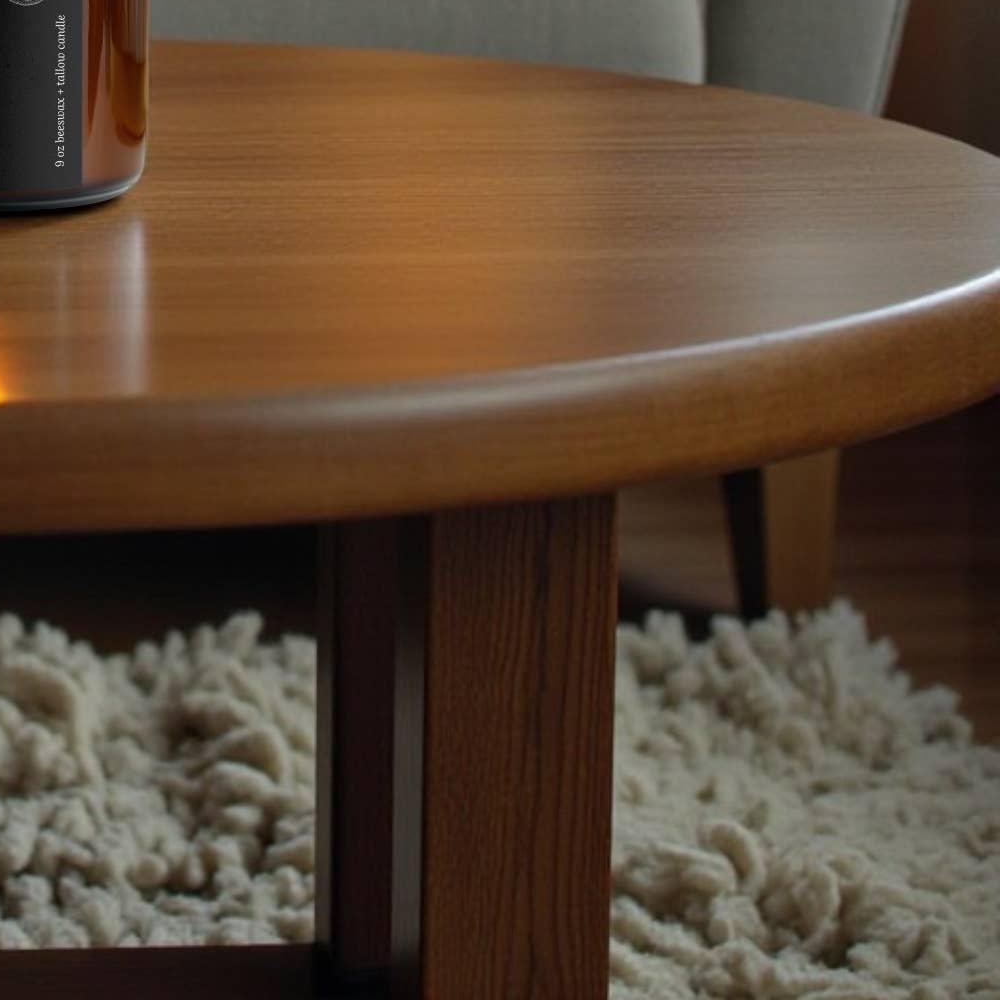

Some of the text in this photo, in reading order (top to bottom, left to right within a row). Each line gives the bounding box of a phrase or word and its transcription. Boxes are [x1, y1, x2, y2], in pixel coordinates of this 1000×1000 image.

[54, 14, 66, 168] 9 oz beeswax + tallow candle
